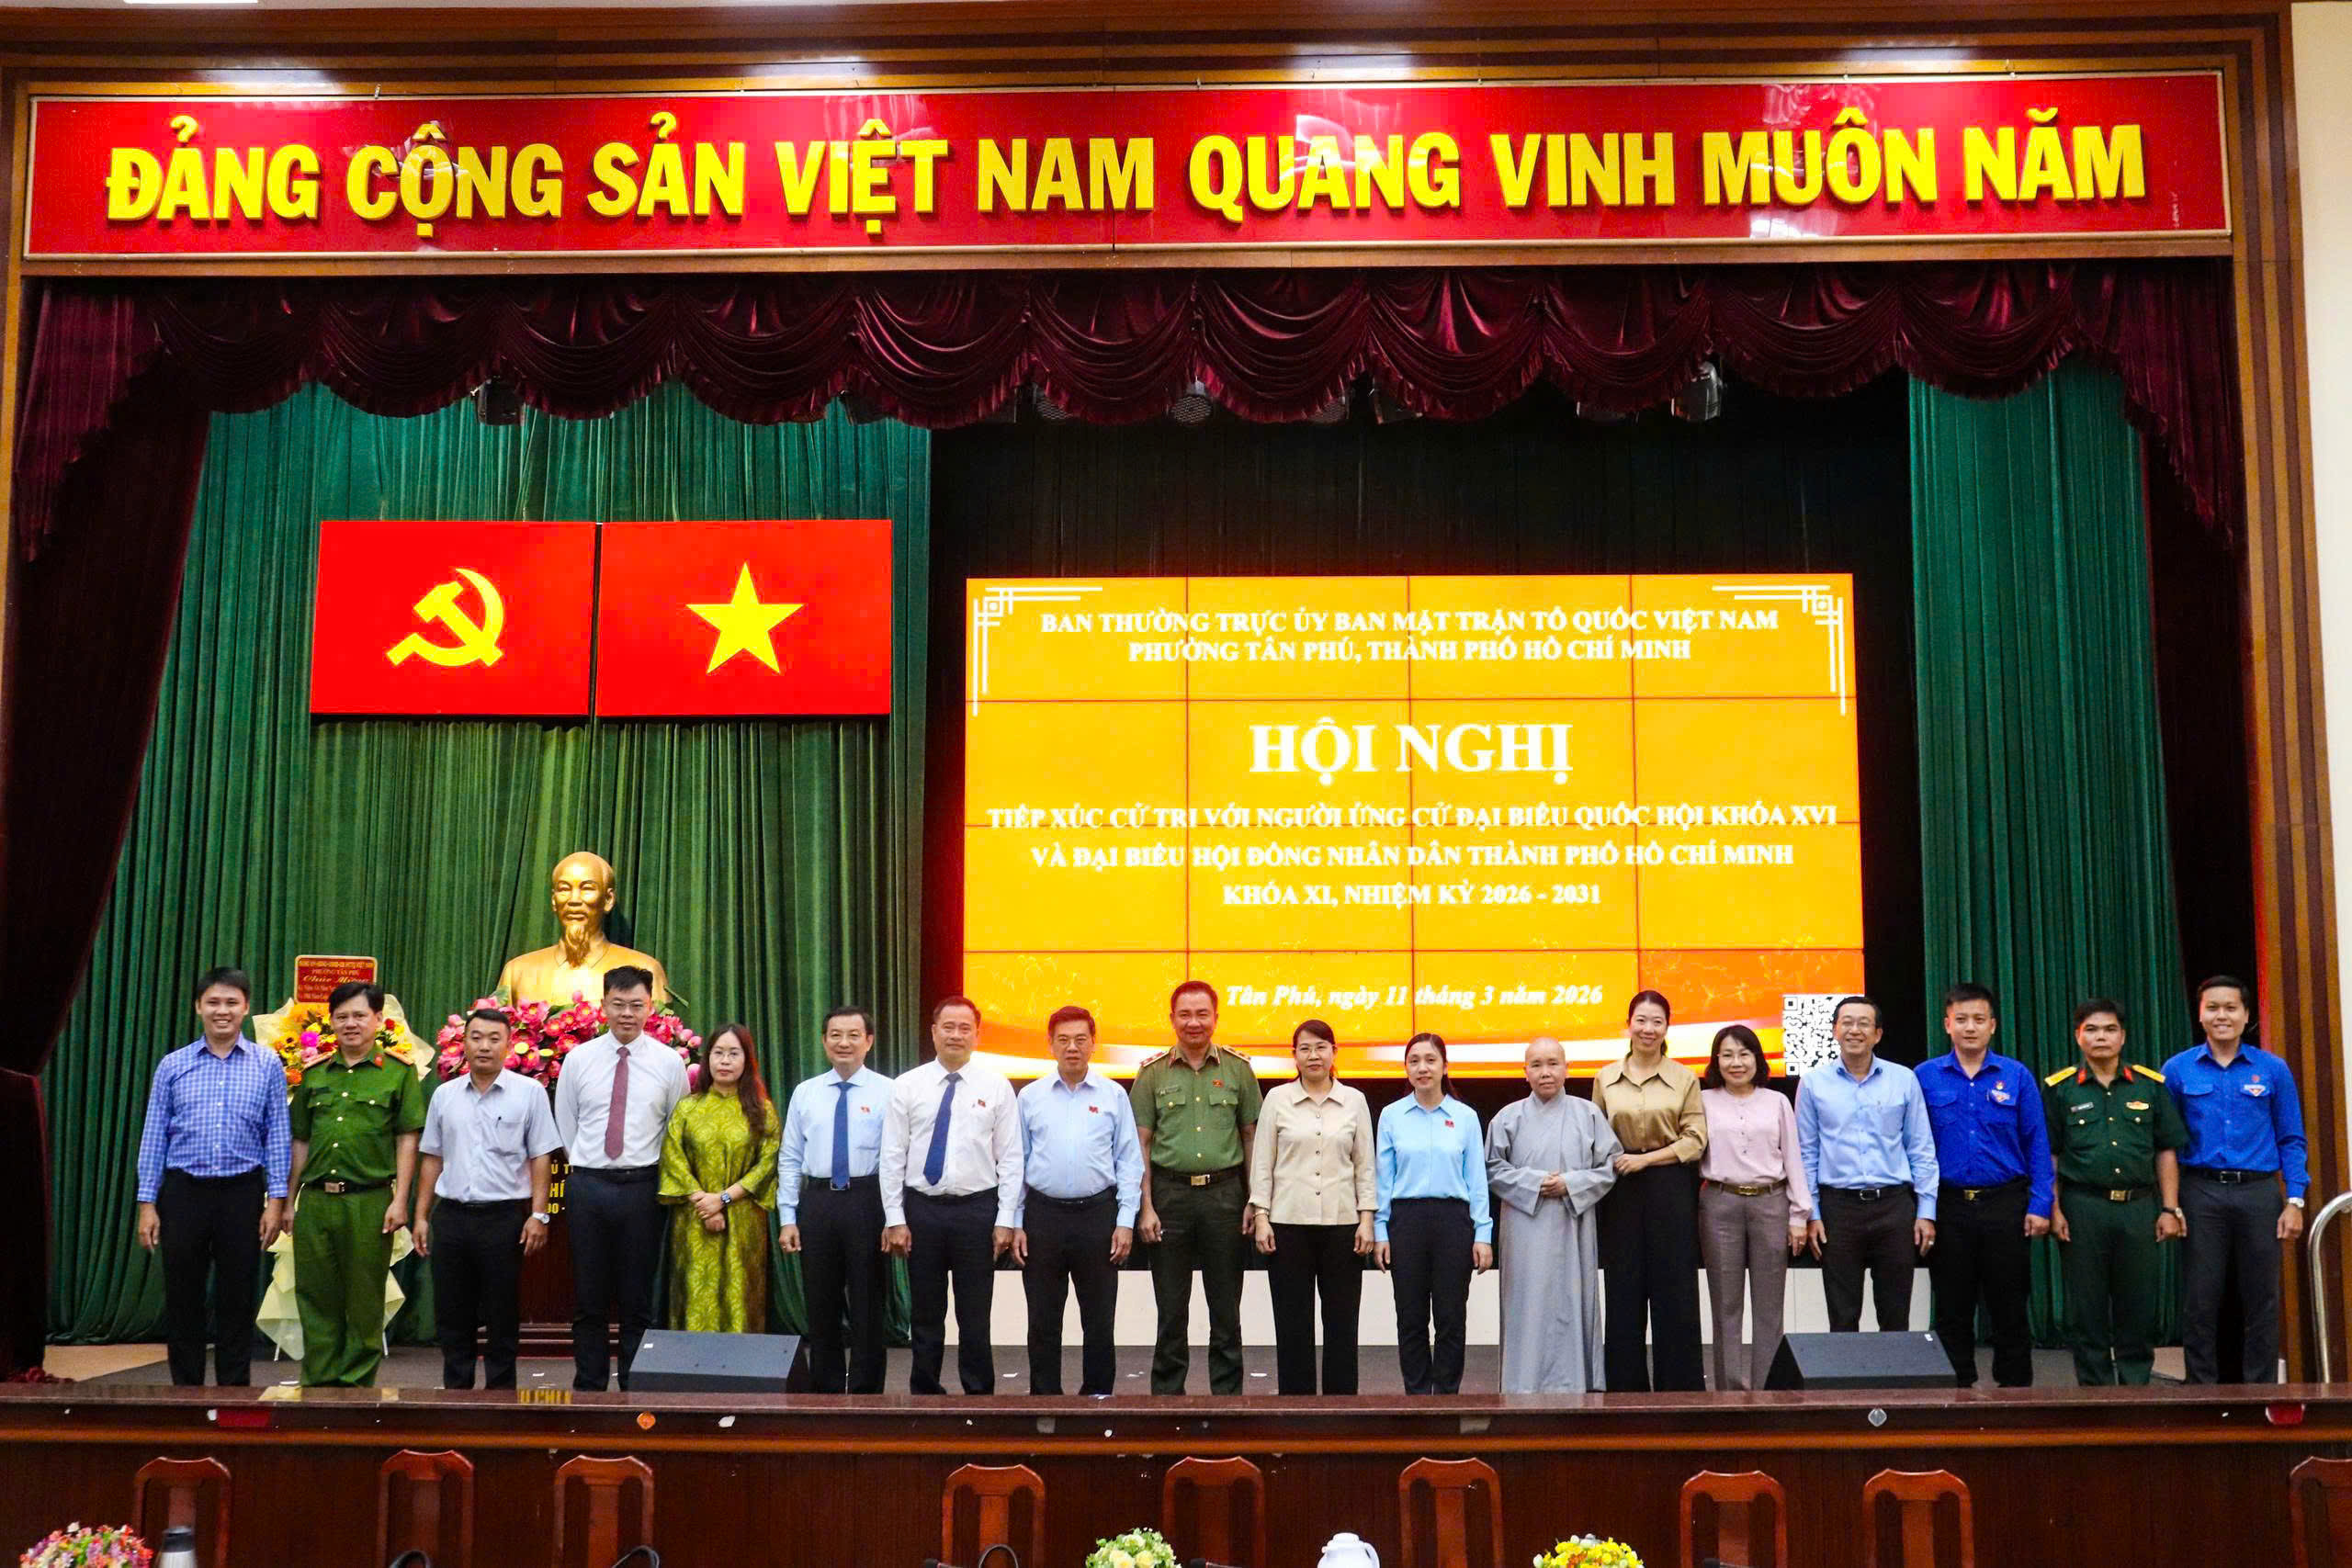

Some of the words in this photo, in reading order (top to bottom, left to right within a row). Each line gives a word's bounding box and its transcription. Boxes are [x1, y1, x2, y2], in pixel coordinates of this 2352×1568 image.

[106, 115, 321, 220] ĐẢNG
[346, 122, 563, 238] CỘNG
[587, 111, 746, 217] SẢN
[775, 118, 948, 234] VIỆT
[978, 137, 1155, 212] NAM
[1189, 132, 1461, 223] QUANG
[1490, 131, 1676, 208] VINH
[1702, 107, 1938, 205] MUÔN
[1962, 107, 2145, 201] NĂM
[1041, 613, 1093, 633] BAN
[1098, 606, 1211, 633] THƯỜNG
[1215, 610, 1287, 637] TRỰC
[1334, 612, 1386, 632] BAN
[1454, 609, 1525, 637] TRẬN
[1572, 605, 1647, 636] QUỐC
[1653, 607, 1714, 636] VIỆT
[1719, 610, 1780, 631] NAM
[1128, 636, 1239, 662] PHƯỜNG
[1244, 636, 1297, 661] TÂN
[1303, 636, 1363, 665] PHÚ,
[1366, 635, 1458, 661] THÀNH
[1464, 635, 1518, 660] PHỐ
[1523, 635, 1563, 660] HỒ
[1566, 635, 1615, 660] CHÍ
[1621, 638, 1691, 660] MINH
[1249, 716, 1378, 786] HỘI
[1396, 723, 1574, 785] NGHỊ
[1049, 803, 1103, 829] XÚC
[1109, 801, 1150, 829] CỬ
[1153, 807, 1198, 829] TRI
[1204, 801, 1251, 829] VỚI
[1256, 801, 1342, 828] NGƯỜI
[1348, 801, 1407, 828] ỨNG
[1411, 800, 1453, 828] CỬ
[1455, 807, 1503, 832] ĐẠI
[1574, 800, 1651, 831] QUỐC
[1657, 803, 1705, 831] HỘI
[1712, 800, 1786, 827] KHÓA
[1791, 805, 1838, 827] XVI
[1030, 841, 1067, 867] VÀ
[1072, 846, 1118, 872] ĐẠI
[1192, 844, 1241, 872] HỘI
[1246, 840, 1322, 867] ĐỒNG
[1327, 840, 1400, 866] NHÂN
[1406, 840, 1462, 866] DÂN
[1465, 840, 1559, 866] THÀNH
[1564, 840, 1621, 866] PHỐ
[1624, 840, 1665, 866] HỒ
[1668, 838, 1717, 866] CHÍ
[1723, 844, 1794, 865] MINH
[1223, 880, 1300, 905] KHÓA
[1303, 884, 1339, 908] XI,
[1344, 881, 1431, 910] NHIỆM
[1480, 884, 1532, 905] 2026
[1536, 892, 1547, 900] -
[1552, 883, 1601, 905] 2031
[1227, 984, 1267, 1007] Tân
[1272, 984, 1321, 1008] Phú,
[1328, 985, 1380, 1011] ngày
[1385, 985, 1408, 1006] 11
[1414, 984, 1476, 1011] tháng
[1479, 985, 1496, 1006] 3
[1498, 984, 1547, 1006] năm
[1551, 984, 1603, 1005] 2026
